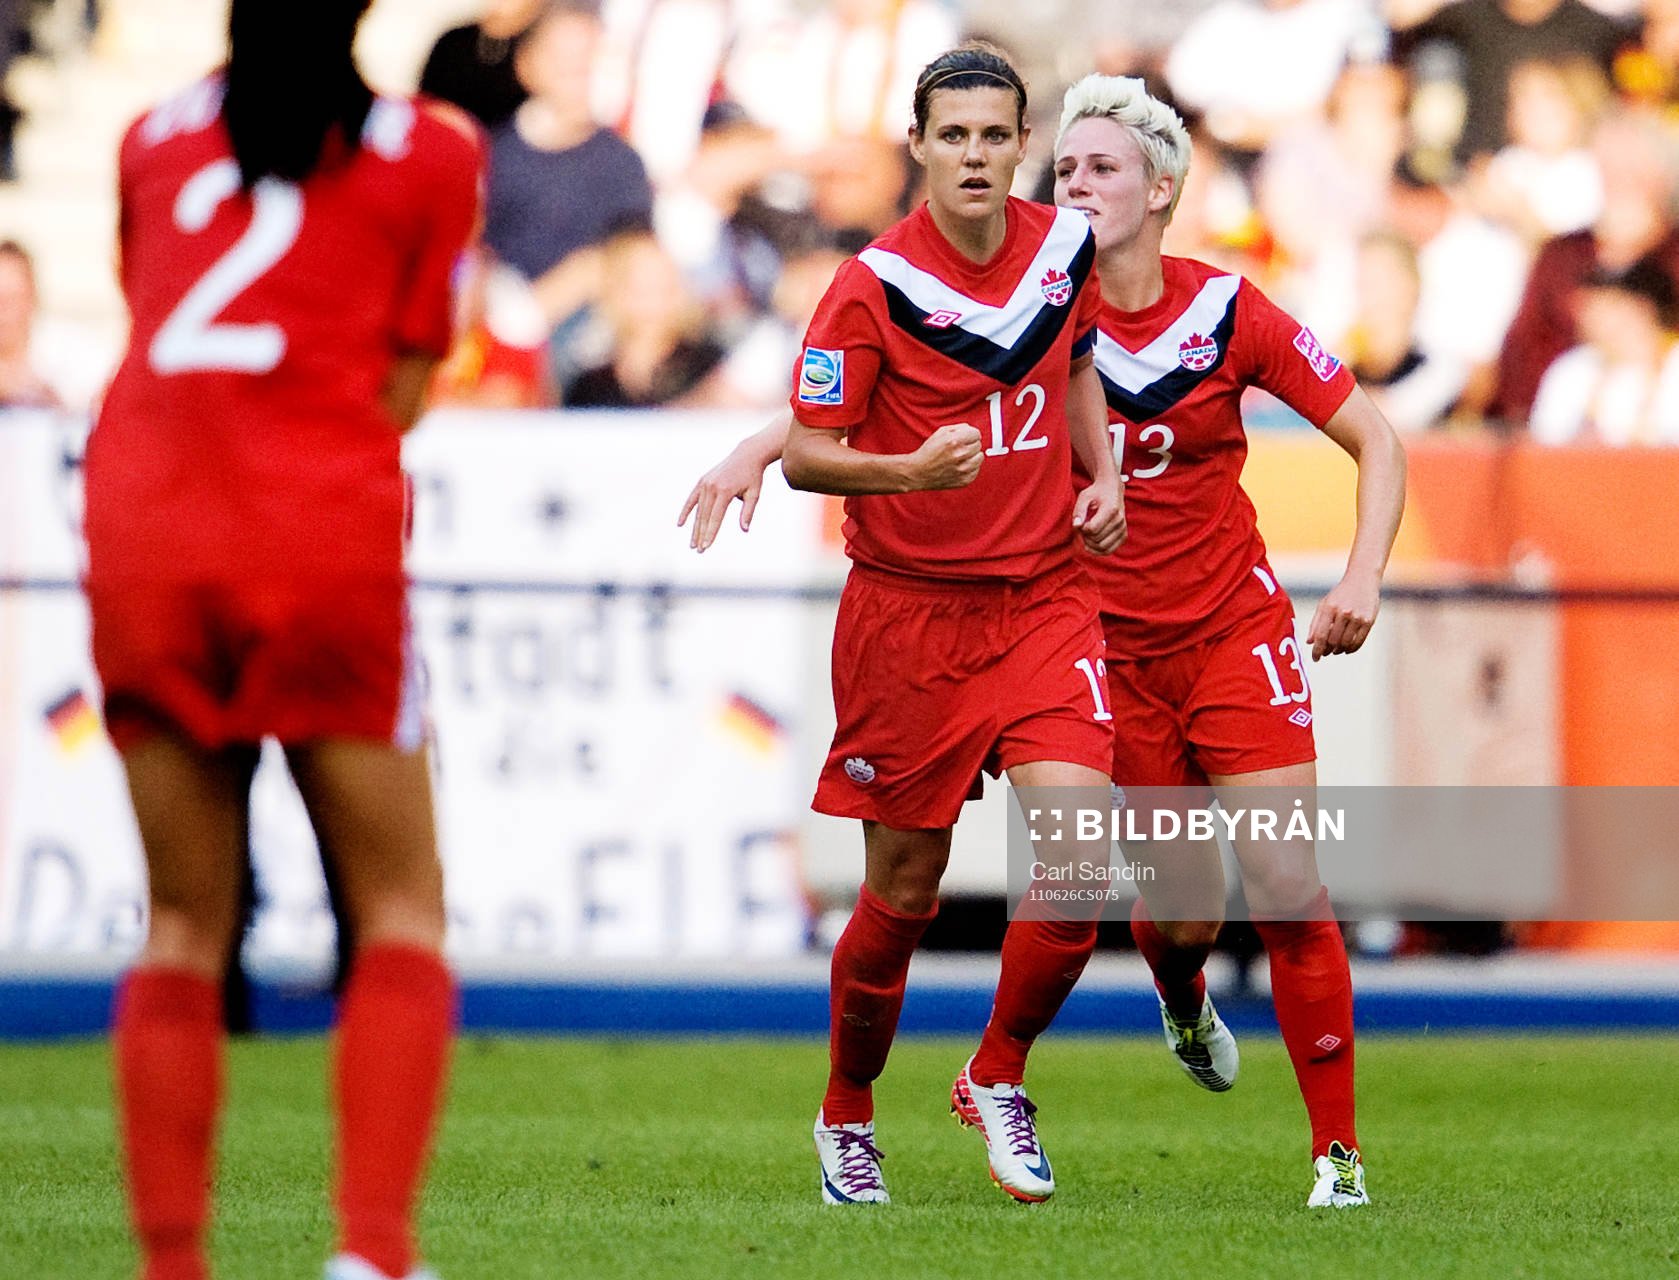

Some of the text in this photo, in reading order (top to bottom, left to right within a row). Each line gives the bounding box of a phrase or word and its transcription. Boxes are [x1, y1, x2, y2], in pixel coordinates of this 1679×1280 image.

[149, 158, 306, 376] 2
[1178, 346, 1217, 358] CANADA
[984, 383, 1049, 457] 12
[1108, 423, 1175, 482] 13
[1251, 636, 1310, 706] 13
